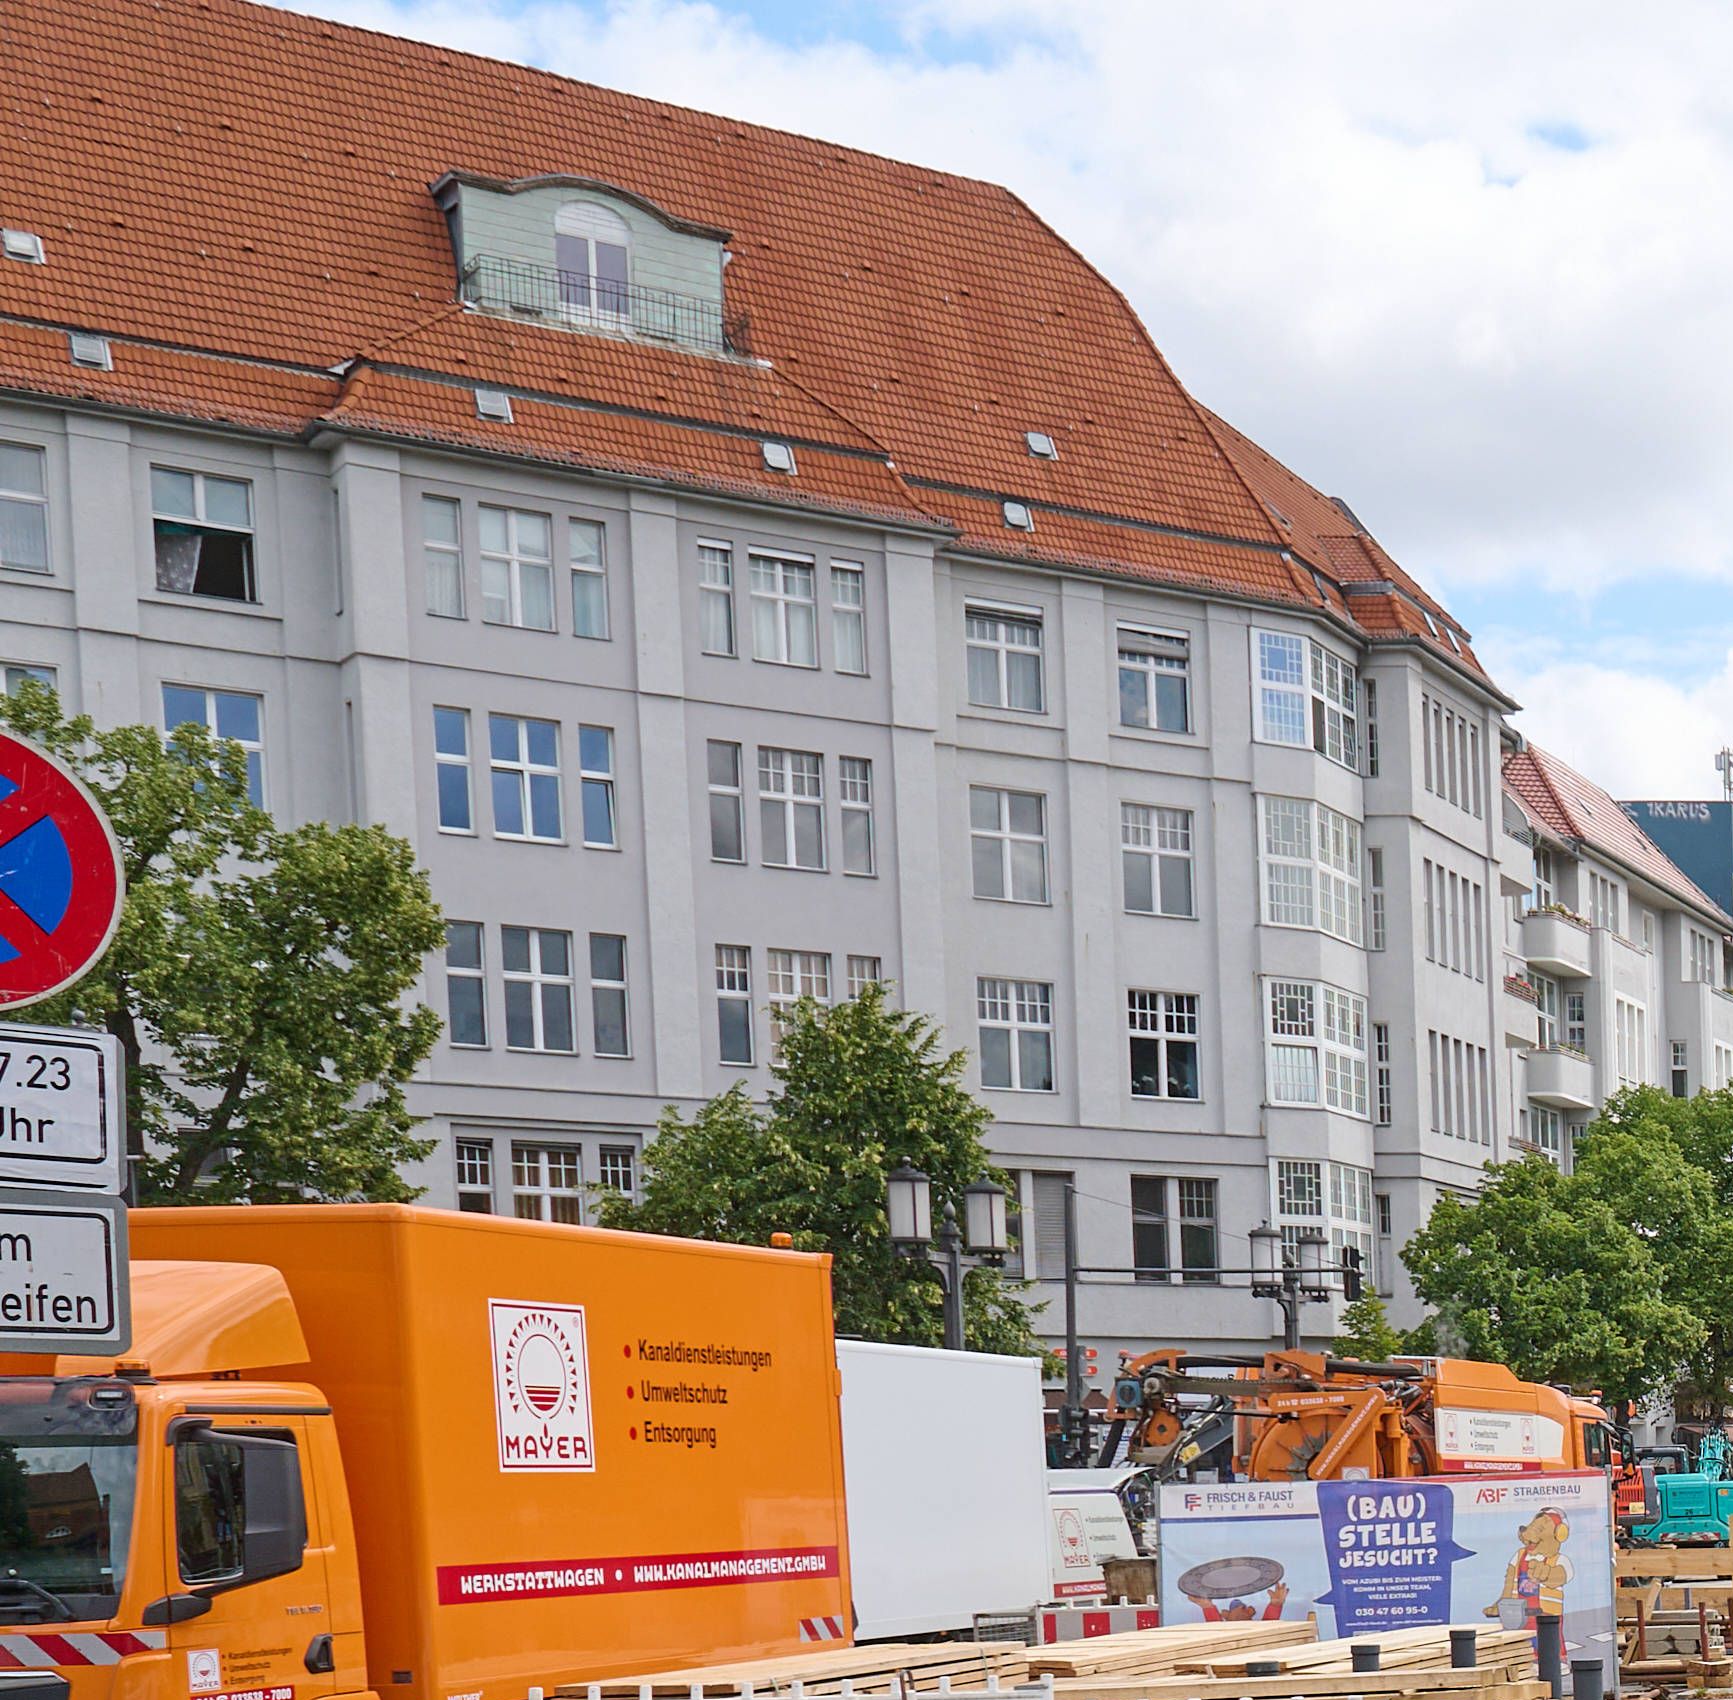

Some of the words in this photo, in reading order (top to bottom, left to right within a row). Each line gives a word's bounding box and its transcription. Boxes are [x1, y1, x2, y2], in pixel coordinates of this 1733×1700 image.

[1647, 802, 1710, 819] IKARUS
[2, 1284, 97, 1324] eifen
[638, 1339, 772, 1372] Kanaldienstleistungen
[641, 1381, 728, 1405] Umweltschutz
[506, 1434, 588, 1459] MAYER
[644, 1421, 717, 1448] Entsorgung
[1207, 1491, 1245, 1503] FRISCH
[1247, 1492, 1256, 1502] &
[1259, 1490, 1293, 1501] FAUST
[1208, 1502, 1294, 1511] TIEFBAU
[1347, 1492, 1426, 1521] (BAU)
[1476, 1488, 1508, 1504] ABF
[1338, 1521, 1436, 1548] STELLE
[1339, 1547, 1438, 1568] JESUCHT?
[461, 1568, 604, 1594] WERKSTATTWAGEN
[634, 1555, 826, 1584] WWW.KANALMANAGEMENT.GMBH
[1355, 1607, 1375, 1616] 030
[1376, 1607, 1389, 1616] 47
[1391, 1606, 1404, 1615] 60
[1406, 1605, 1428, 1614] 95-0
[271, 1688, 292, 1700] 7000
